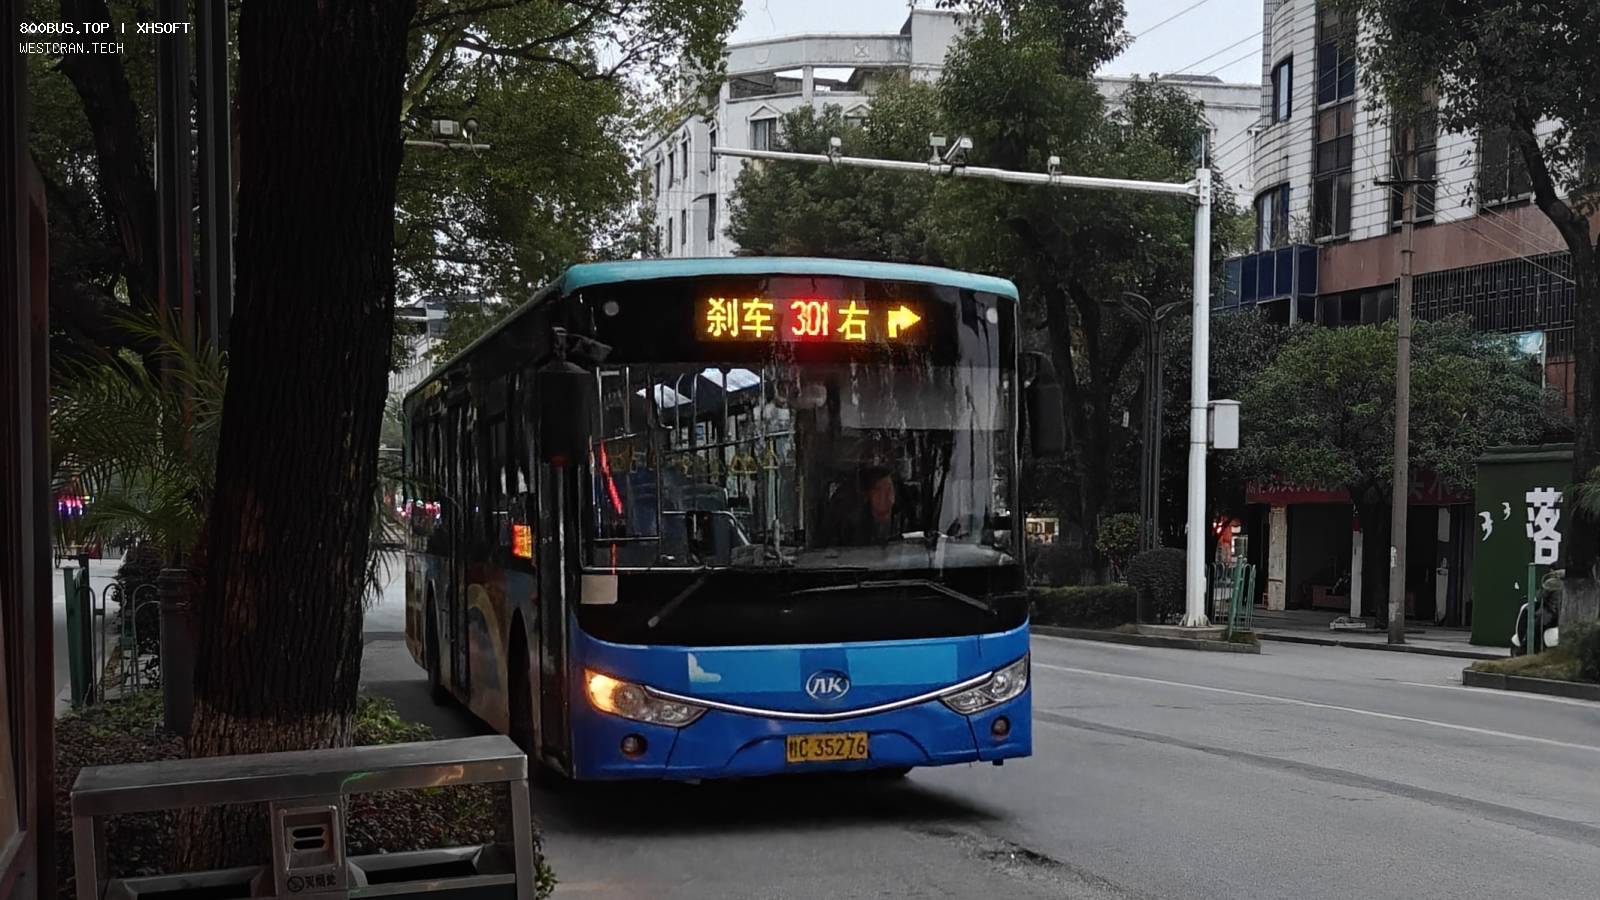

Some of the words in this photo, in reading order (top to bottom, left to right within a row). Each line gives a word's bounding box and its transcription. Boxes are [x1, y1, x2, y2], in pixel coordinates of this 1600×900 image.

[707, 297, 774, 337] 刹车
[790, 300, 829, 336] 301
[837, 300, 870, 341] 右
[1525, 487, 1563, 565] 落
